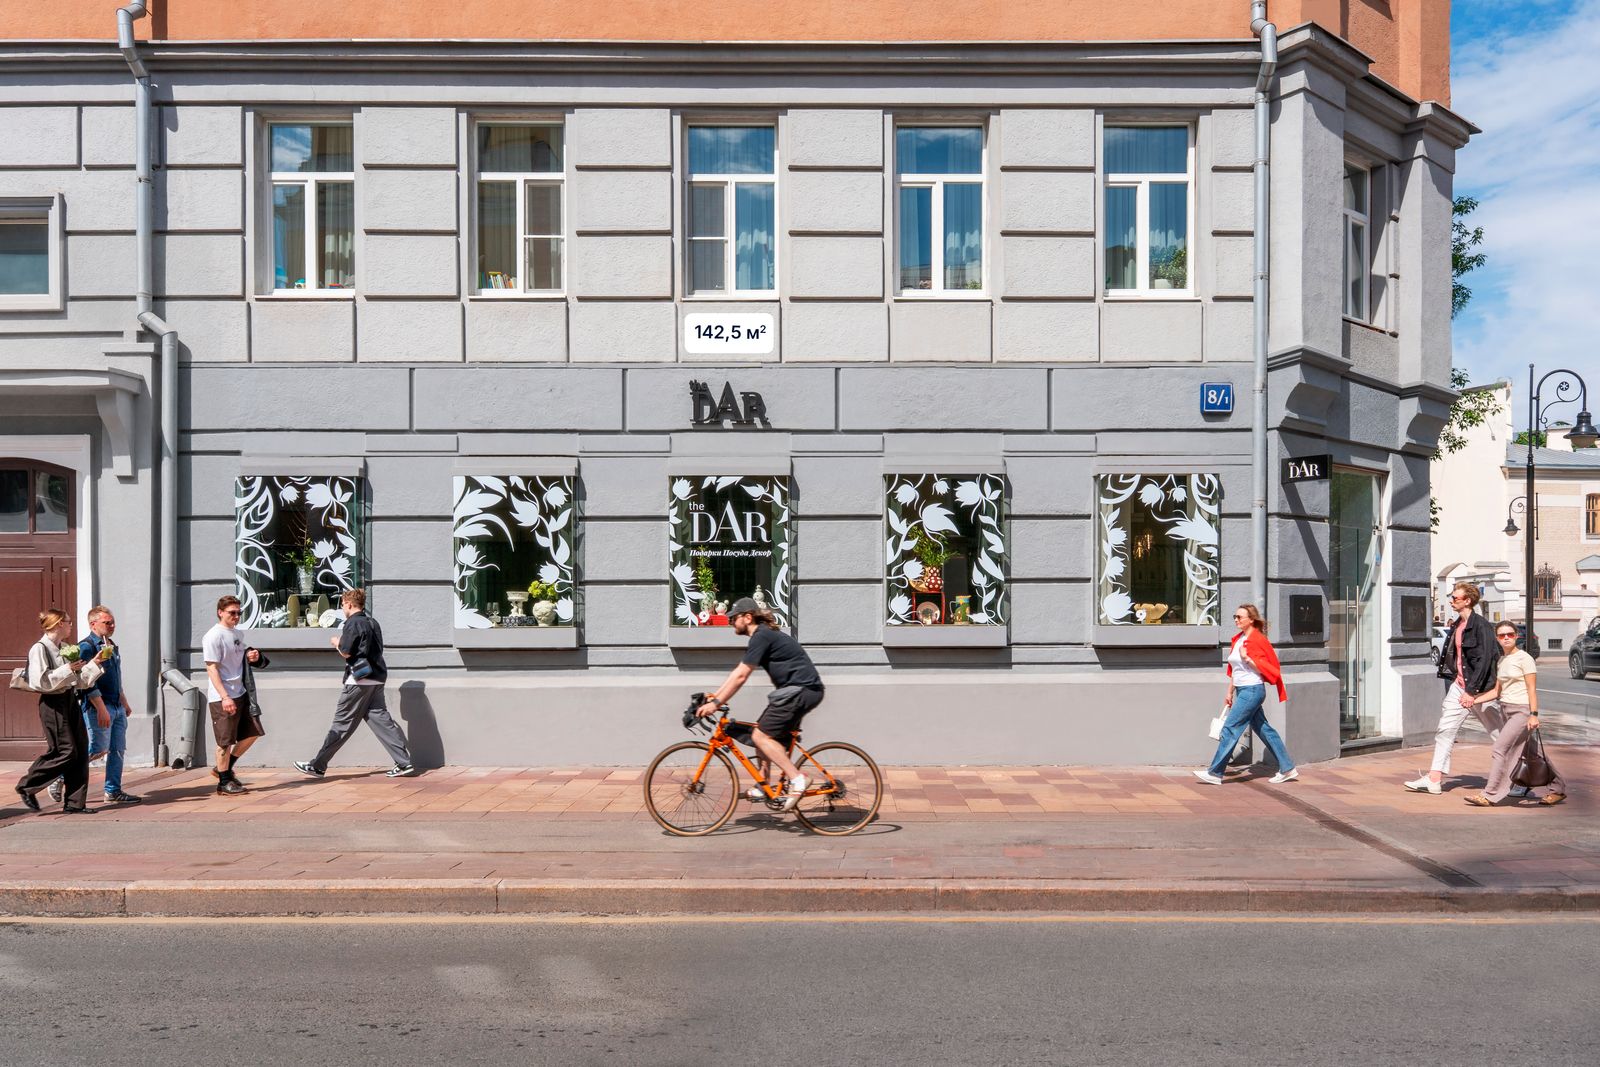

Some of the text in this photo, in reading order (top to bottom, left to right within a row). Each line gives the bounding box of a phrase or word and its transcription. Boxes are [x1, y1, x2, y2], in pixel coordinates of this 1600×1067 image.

[690, 381, 772, 428] DAR
[1207, 390, 1229, 406] 8/1
[1289, 460, 1320, 478] DAR
[689, 502, 705, 511] the
[689, 501, 772, 543] DAR
[689, 549, 772, 557] Подарки Посуда Декор
